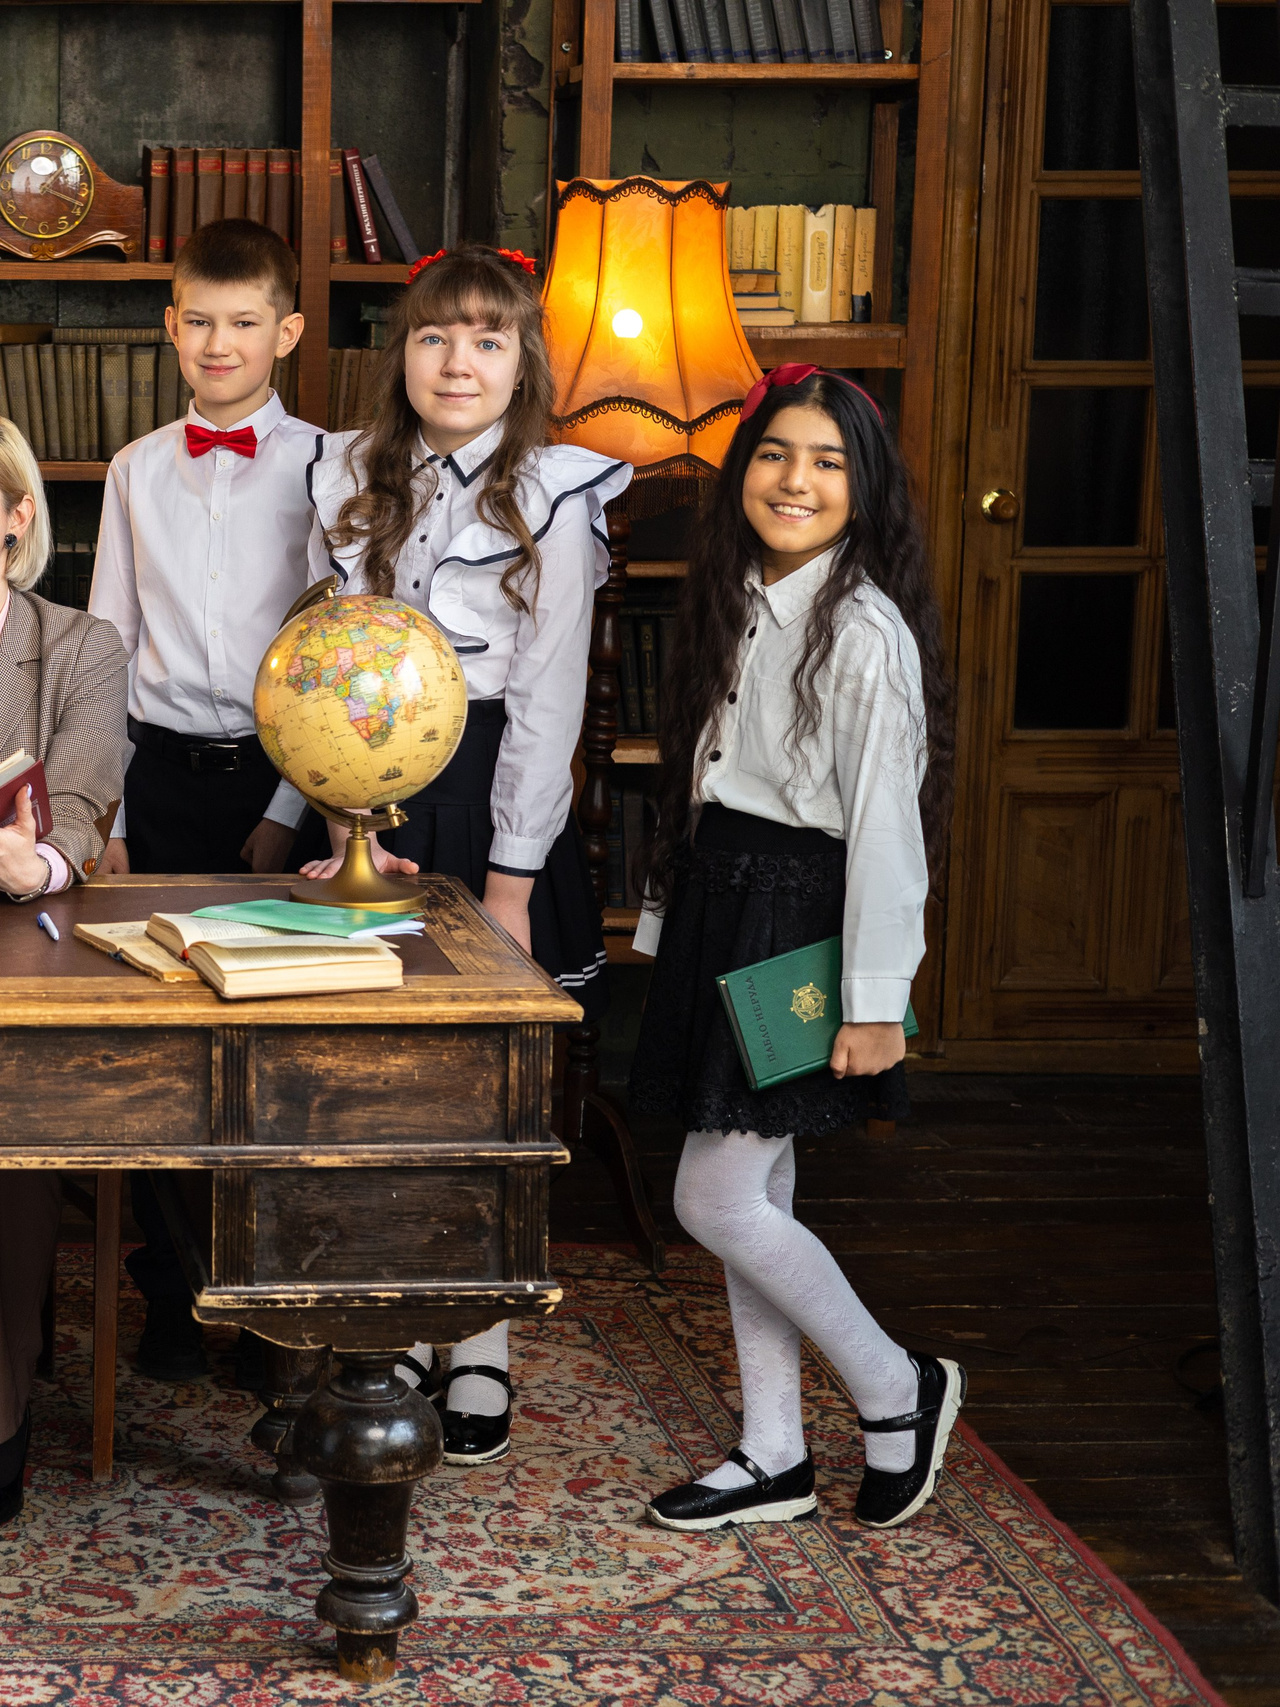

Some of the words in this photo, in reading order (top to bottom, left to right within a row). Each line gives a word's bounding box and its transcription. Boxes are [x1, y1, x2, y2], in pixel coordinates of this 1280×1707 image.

[21, 147, 31, 159] 11
[5, 161, 18, 174] 10
[0, 180, 11, 193] 9
[78, 183, 88, 197] 3
[6, 200, 16, 214] 8
[71, 205, 81, 216] 4
[19, 216, 28, 227] 7
[38, 222, 49, 234] 6
[57, 216, 68, 229] 5
[745, 975, 763, 1015] НЕРУДА
[758, 1024, 776, 1062] ПАБЛО
